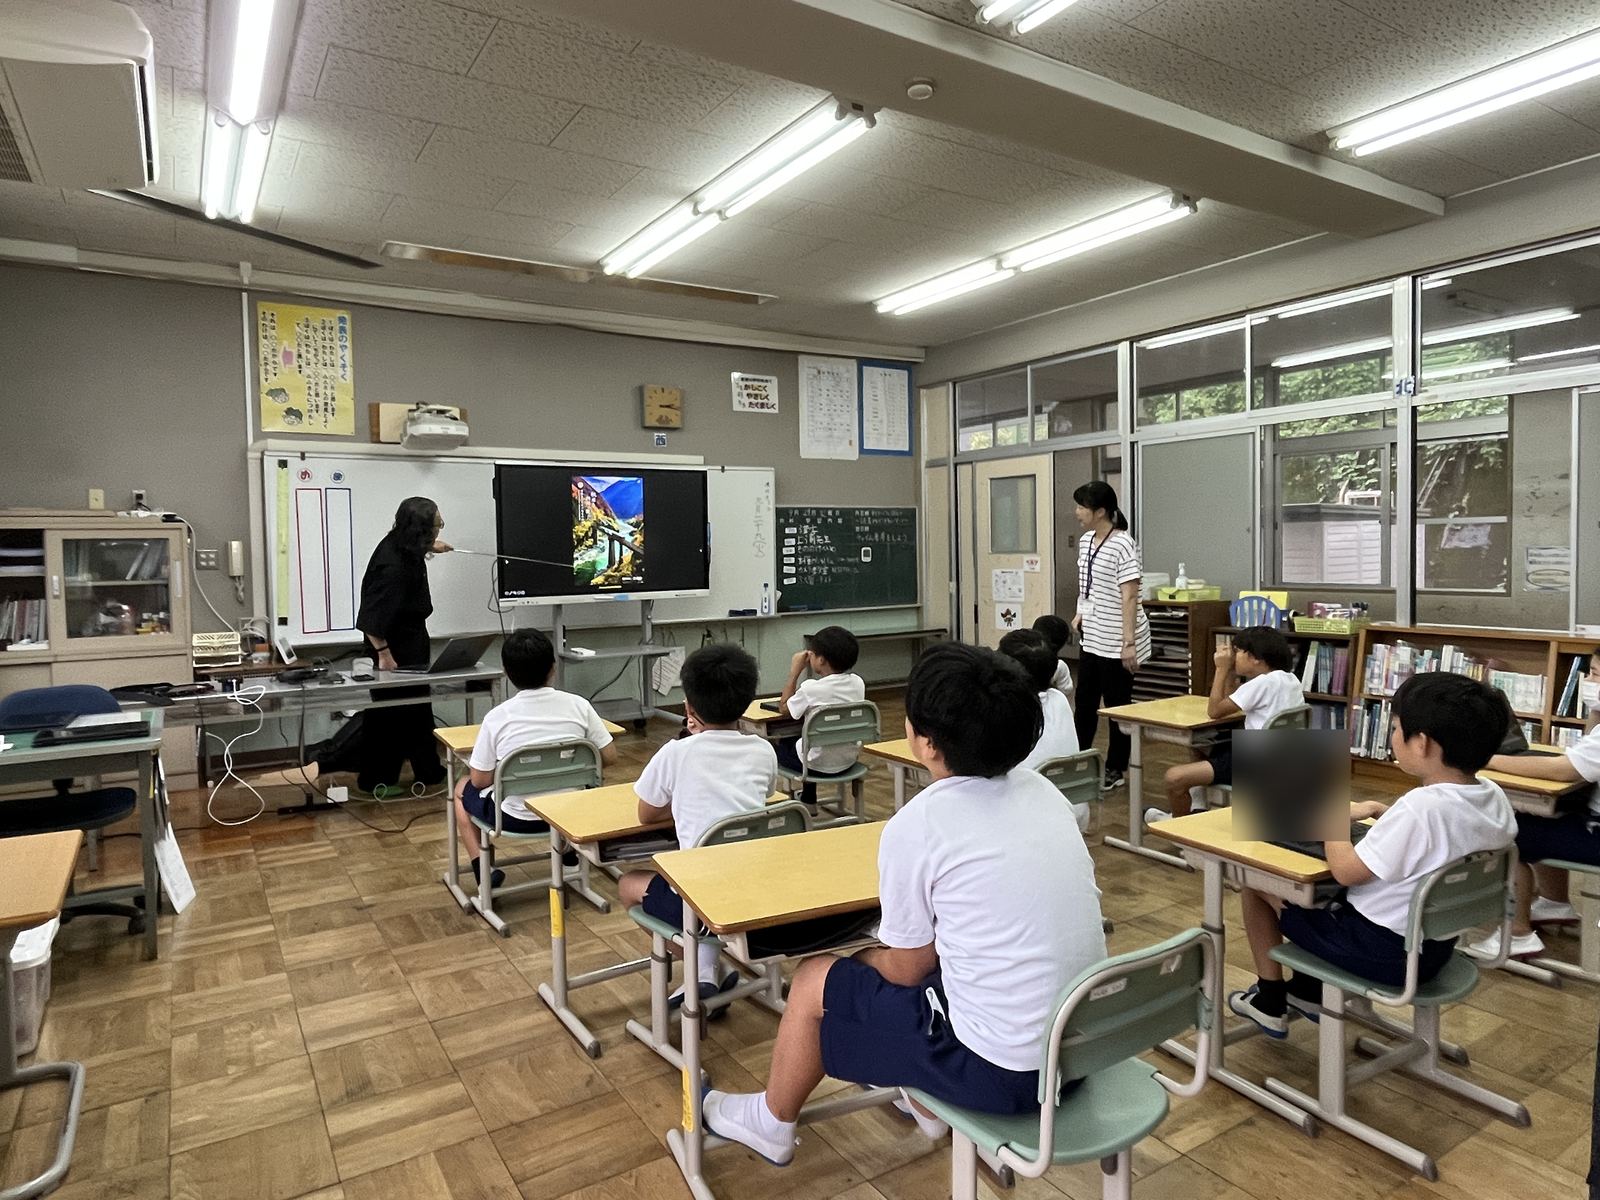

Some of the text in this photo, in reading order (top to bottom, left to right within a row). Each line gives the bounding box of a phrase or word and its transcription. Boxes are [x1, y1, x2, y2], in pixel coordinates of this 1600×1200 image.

[744, 384, 768, 393] かしこく
[1396, 379, 1412, 394] 北
[746, 393, 770, 401] やさしく
[748, 401, 777, 410] たくましく
